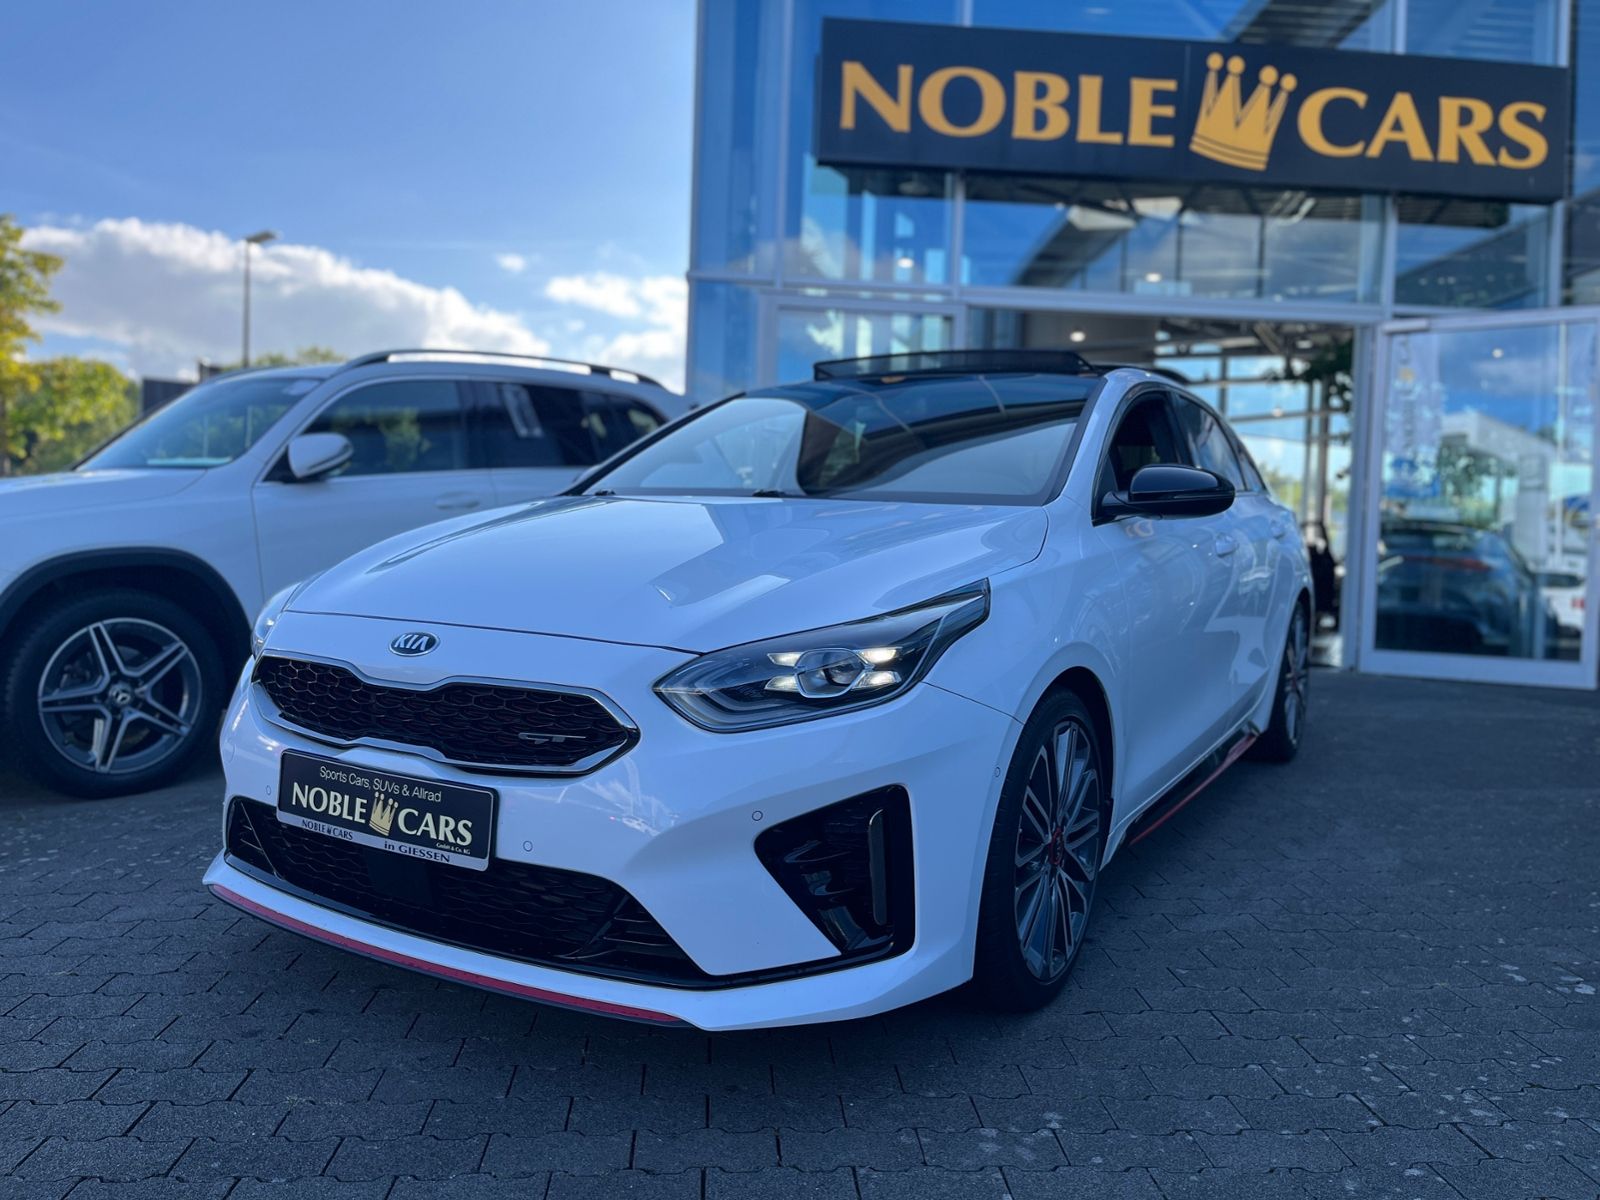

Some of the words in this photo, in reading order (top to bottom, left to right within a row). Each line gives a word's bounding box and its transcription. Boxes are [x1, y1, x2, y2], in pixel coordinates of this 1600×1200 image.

[839, 61, 1178, 148] NOBLE
[1297, 86, 1549, 170] CARS
[393, 634, 430, 651] KIA
[319, 766, 347, 782] Sports
[348, 773, 371, 790] Cars,
[372, 778, 400, 795] SUVs
[401, 784, 410, 797] &
[411, 786, 442, 802] Allrad
[291, 782, 368, 824] NOBLE
[398, 807, 473, 847] CARS
[301, 818, 327, 834] NOBLE
[332, 826, 354, 841] CARS
[383, 841, 395, 851] in
[398, 844, 451, 863] GIESSEN
